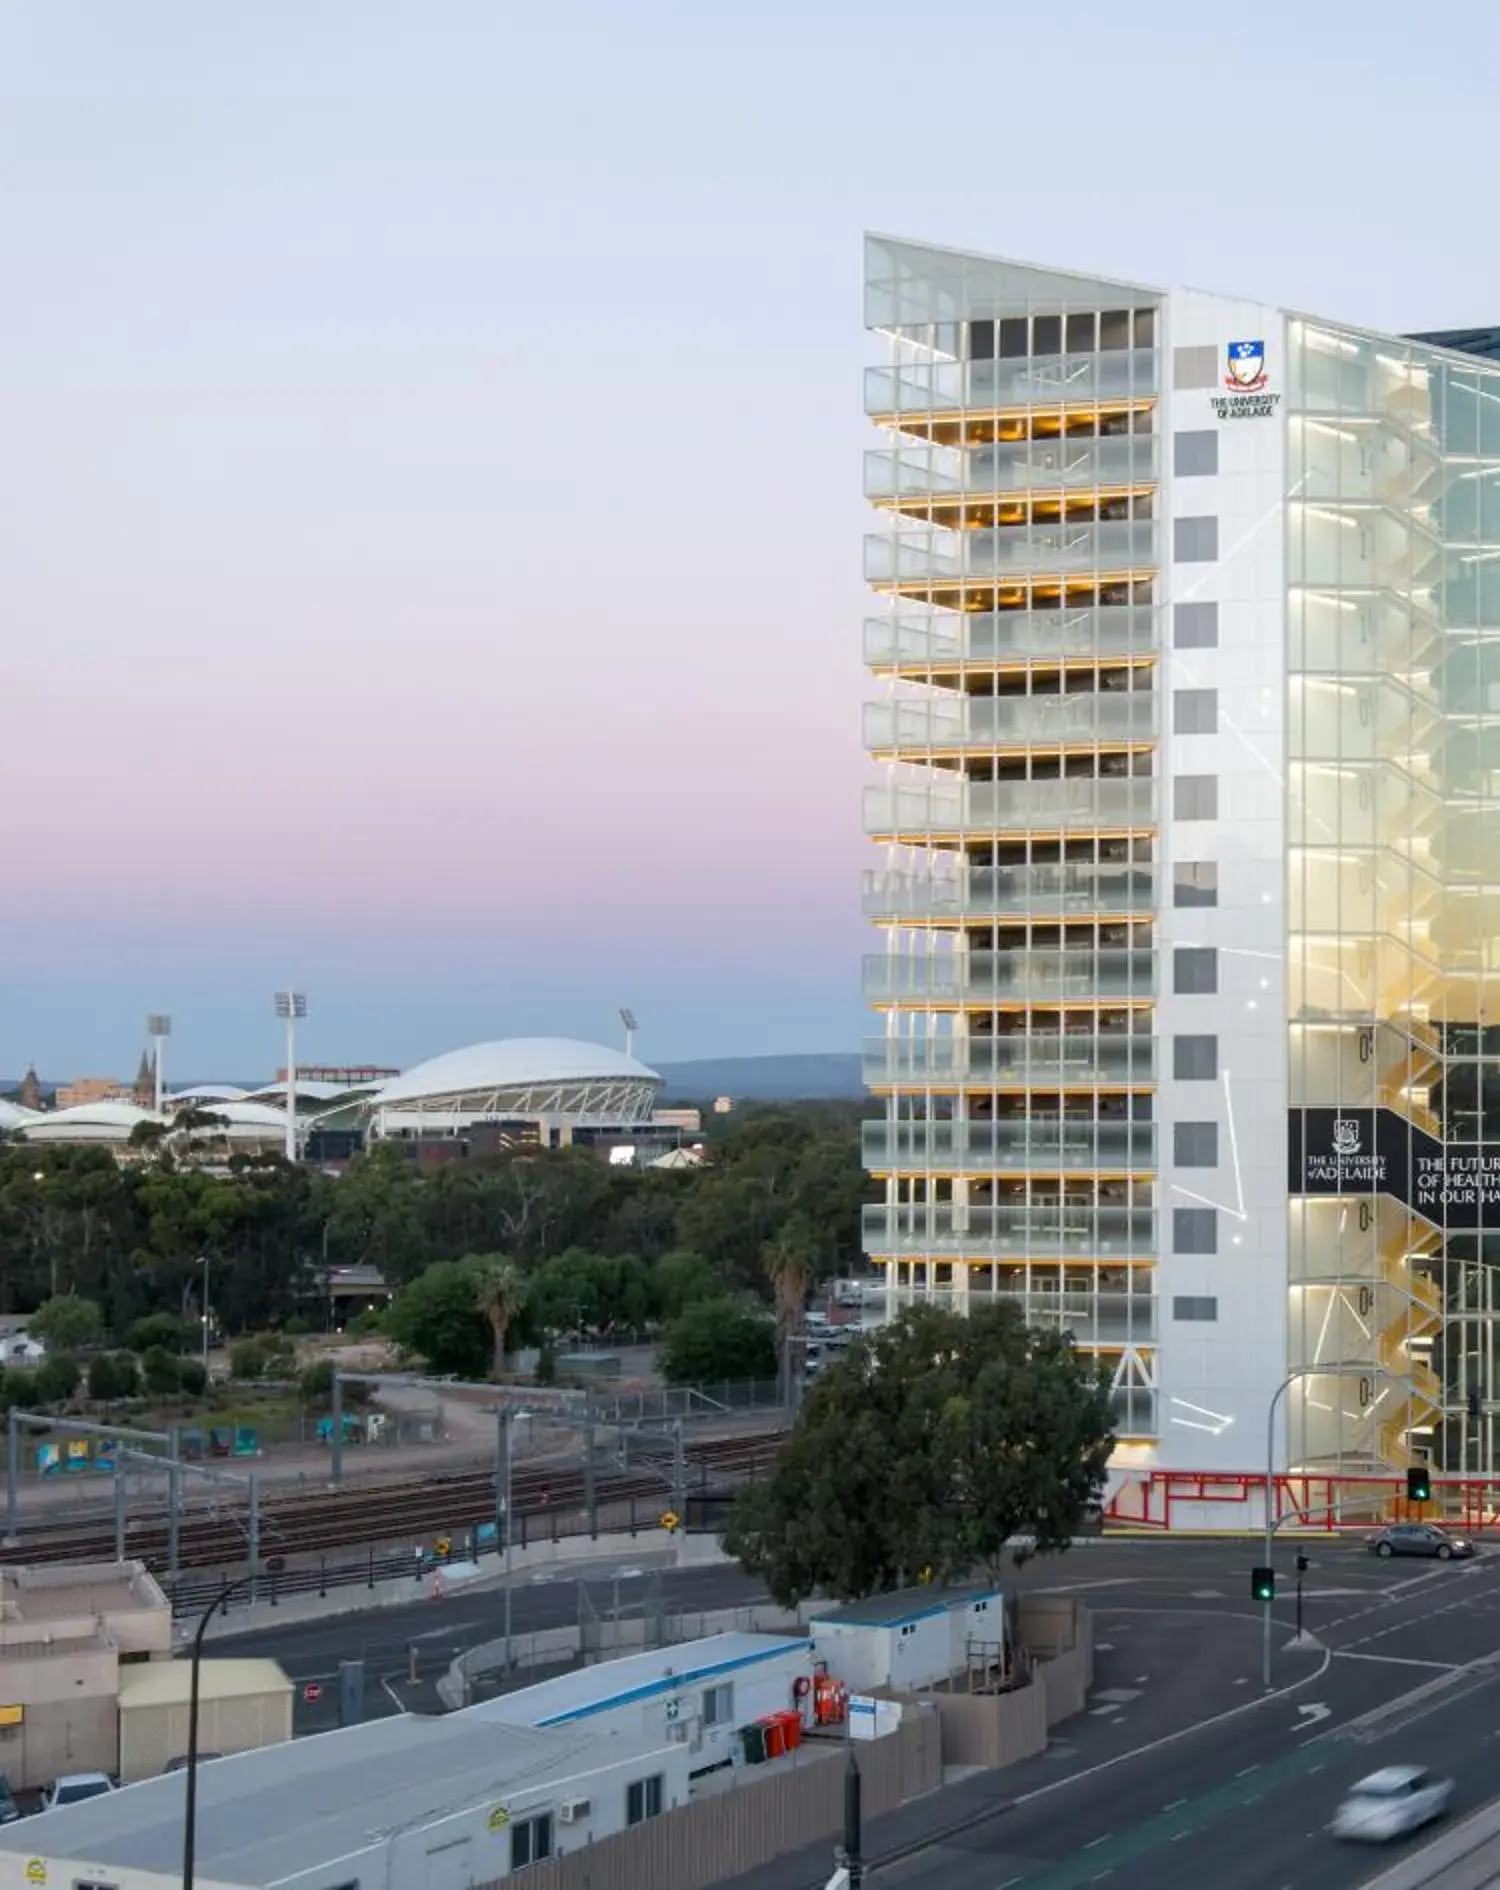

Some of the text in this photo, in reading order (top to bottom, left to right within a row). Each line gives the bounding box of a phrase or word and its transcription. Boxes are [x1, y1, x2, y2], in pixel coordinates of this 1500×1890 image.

[1210, 394, 1281, 408] THE UNIVERSITY
[1217, 405, 1273, 418] OF ADELAIDE
[1308, 1155, 1327, 1165] THE
[1417, 1157, 1445, 1171] THE
[1316, 1167, 1387, 1180] ADELAIDE
[1417, 1173, 1440, 1188] OF
[1418, 1190, 1436, 1204] IN
[1440, 1189, 1476, 1203] OUR
